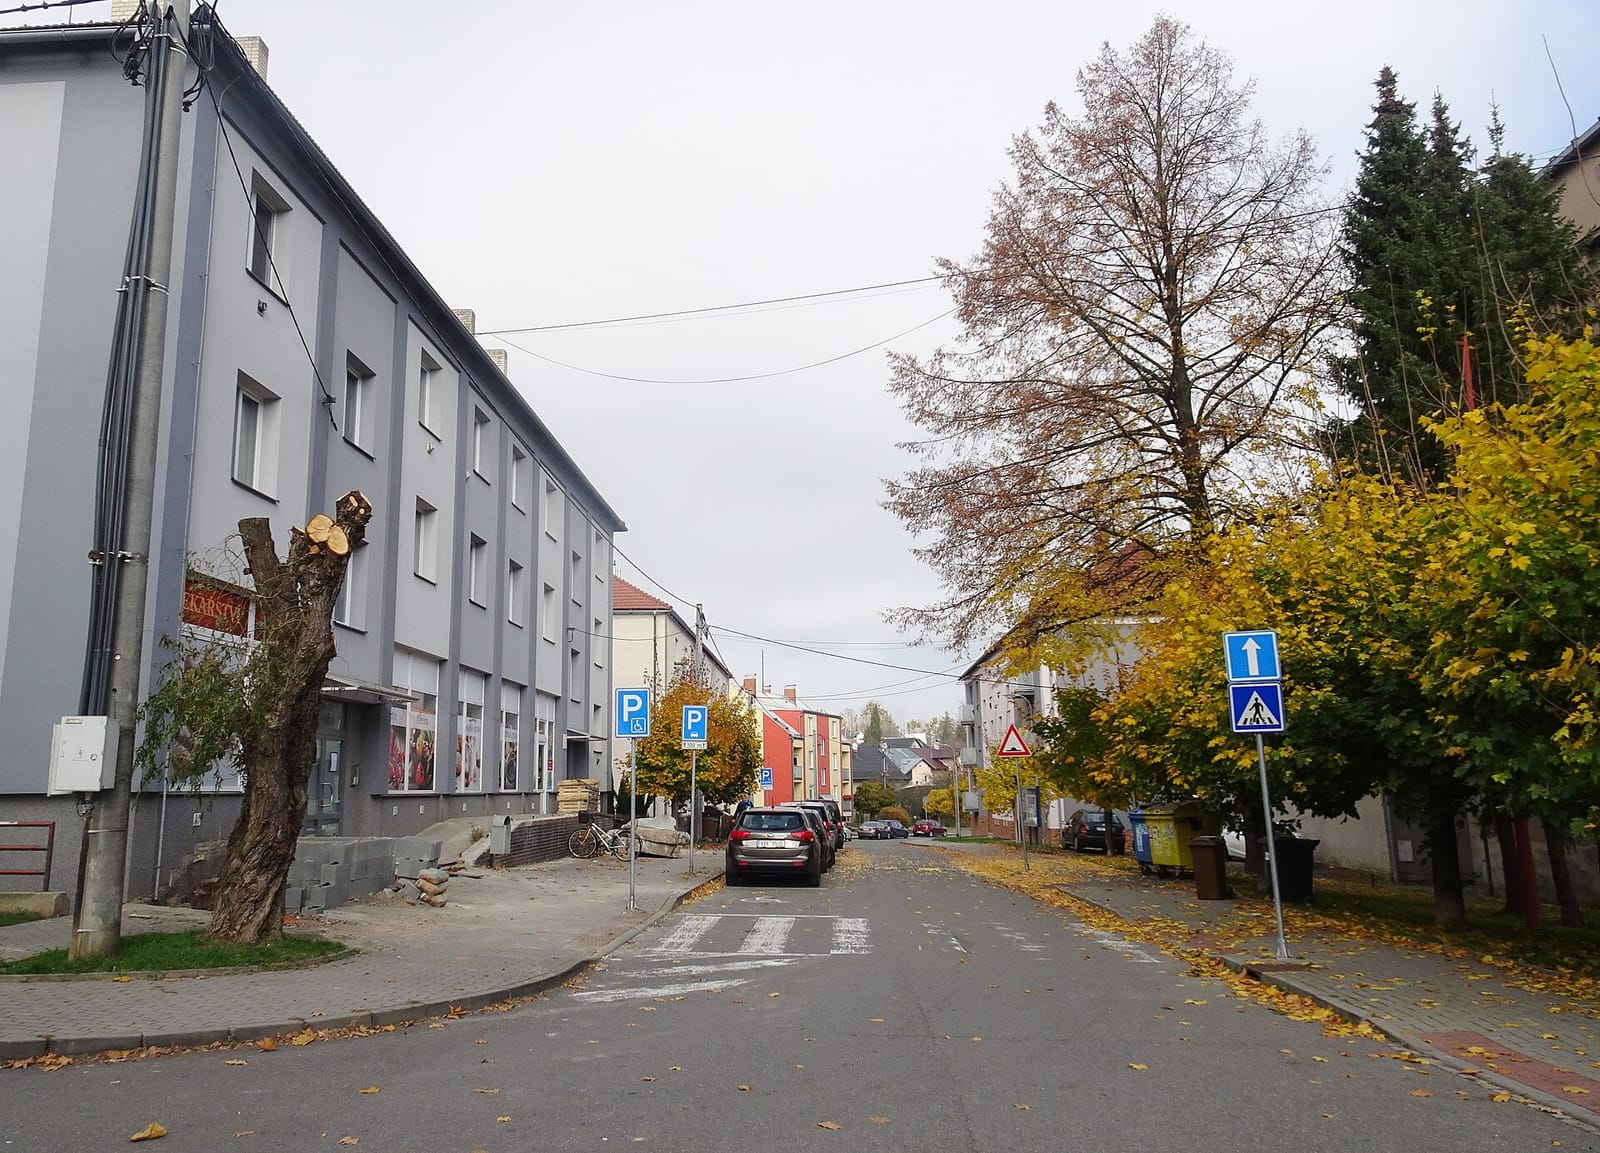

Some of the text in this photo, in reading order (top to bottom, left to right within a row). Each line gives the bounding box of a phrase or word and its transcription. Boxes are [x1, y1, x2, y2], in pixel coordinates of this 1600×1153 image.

[623, 694, 643, 722] P
[687, 710, 702, 730] P
[762, 770, 770, 781] P
